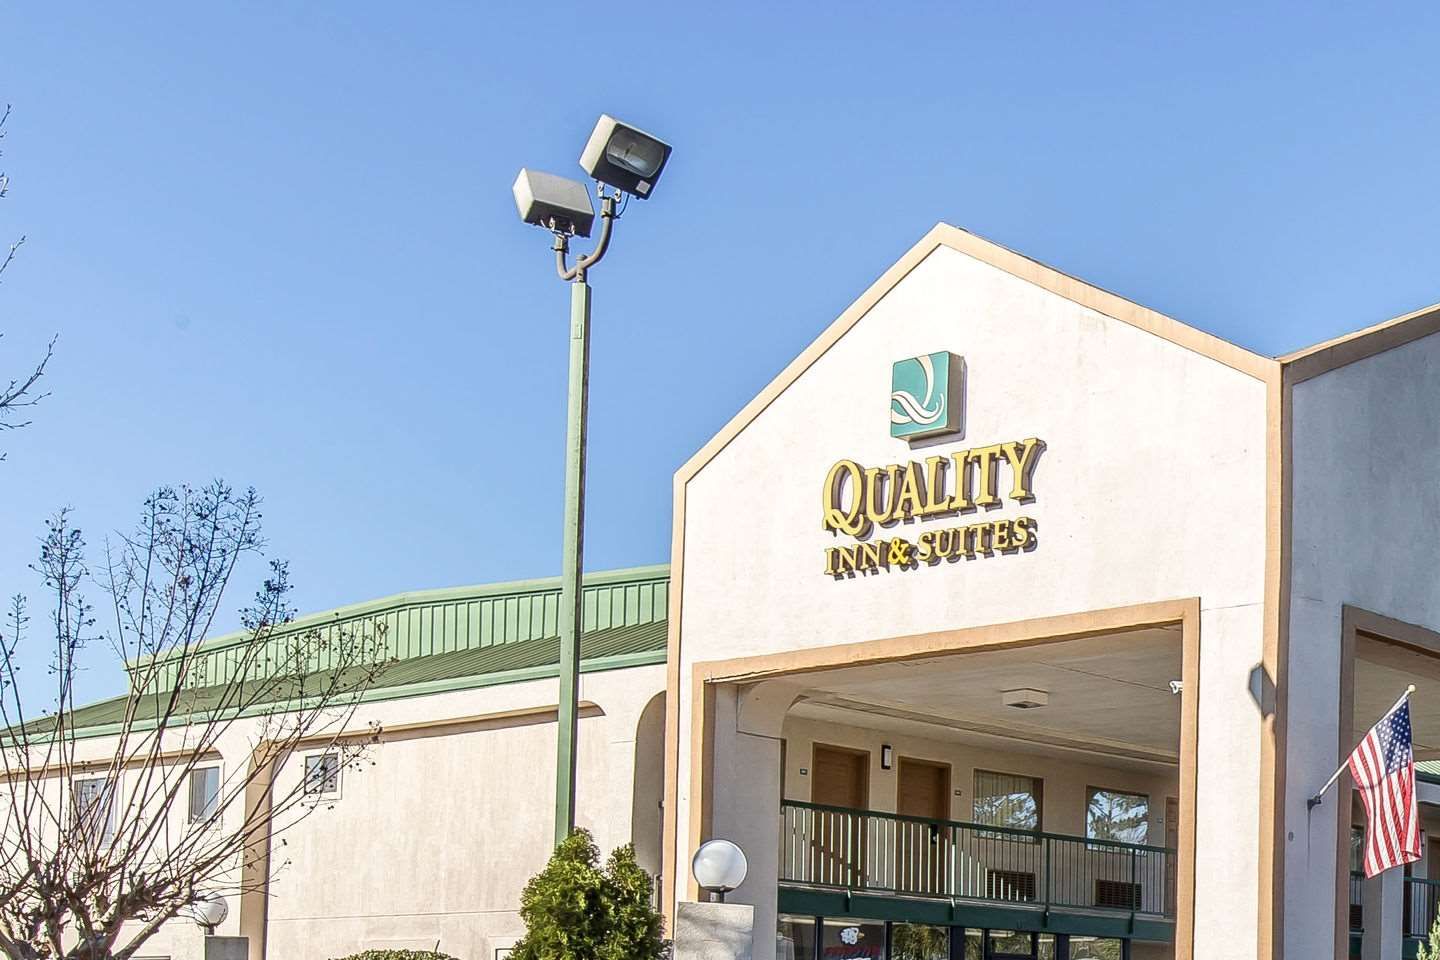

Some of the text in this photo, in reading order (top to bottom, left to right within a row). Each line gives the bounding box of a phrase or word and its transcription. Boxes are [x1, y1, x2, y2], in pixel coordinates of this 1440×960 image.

[822, 437, 1042, 537] QUALITY
[824, 516, 1031, 577] INN & SUITES
